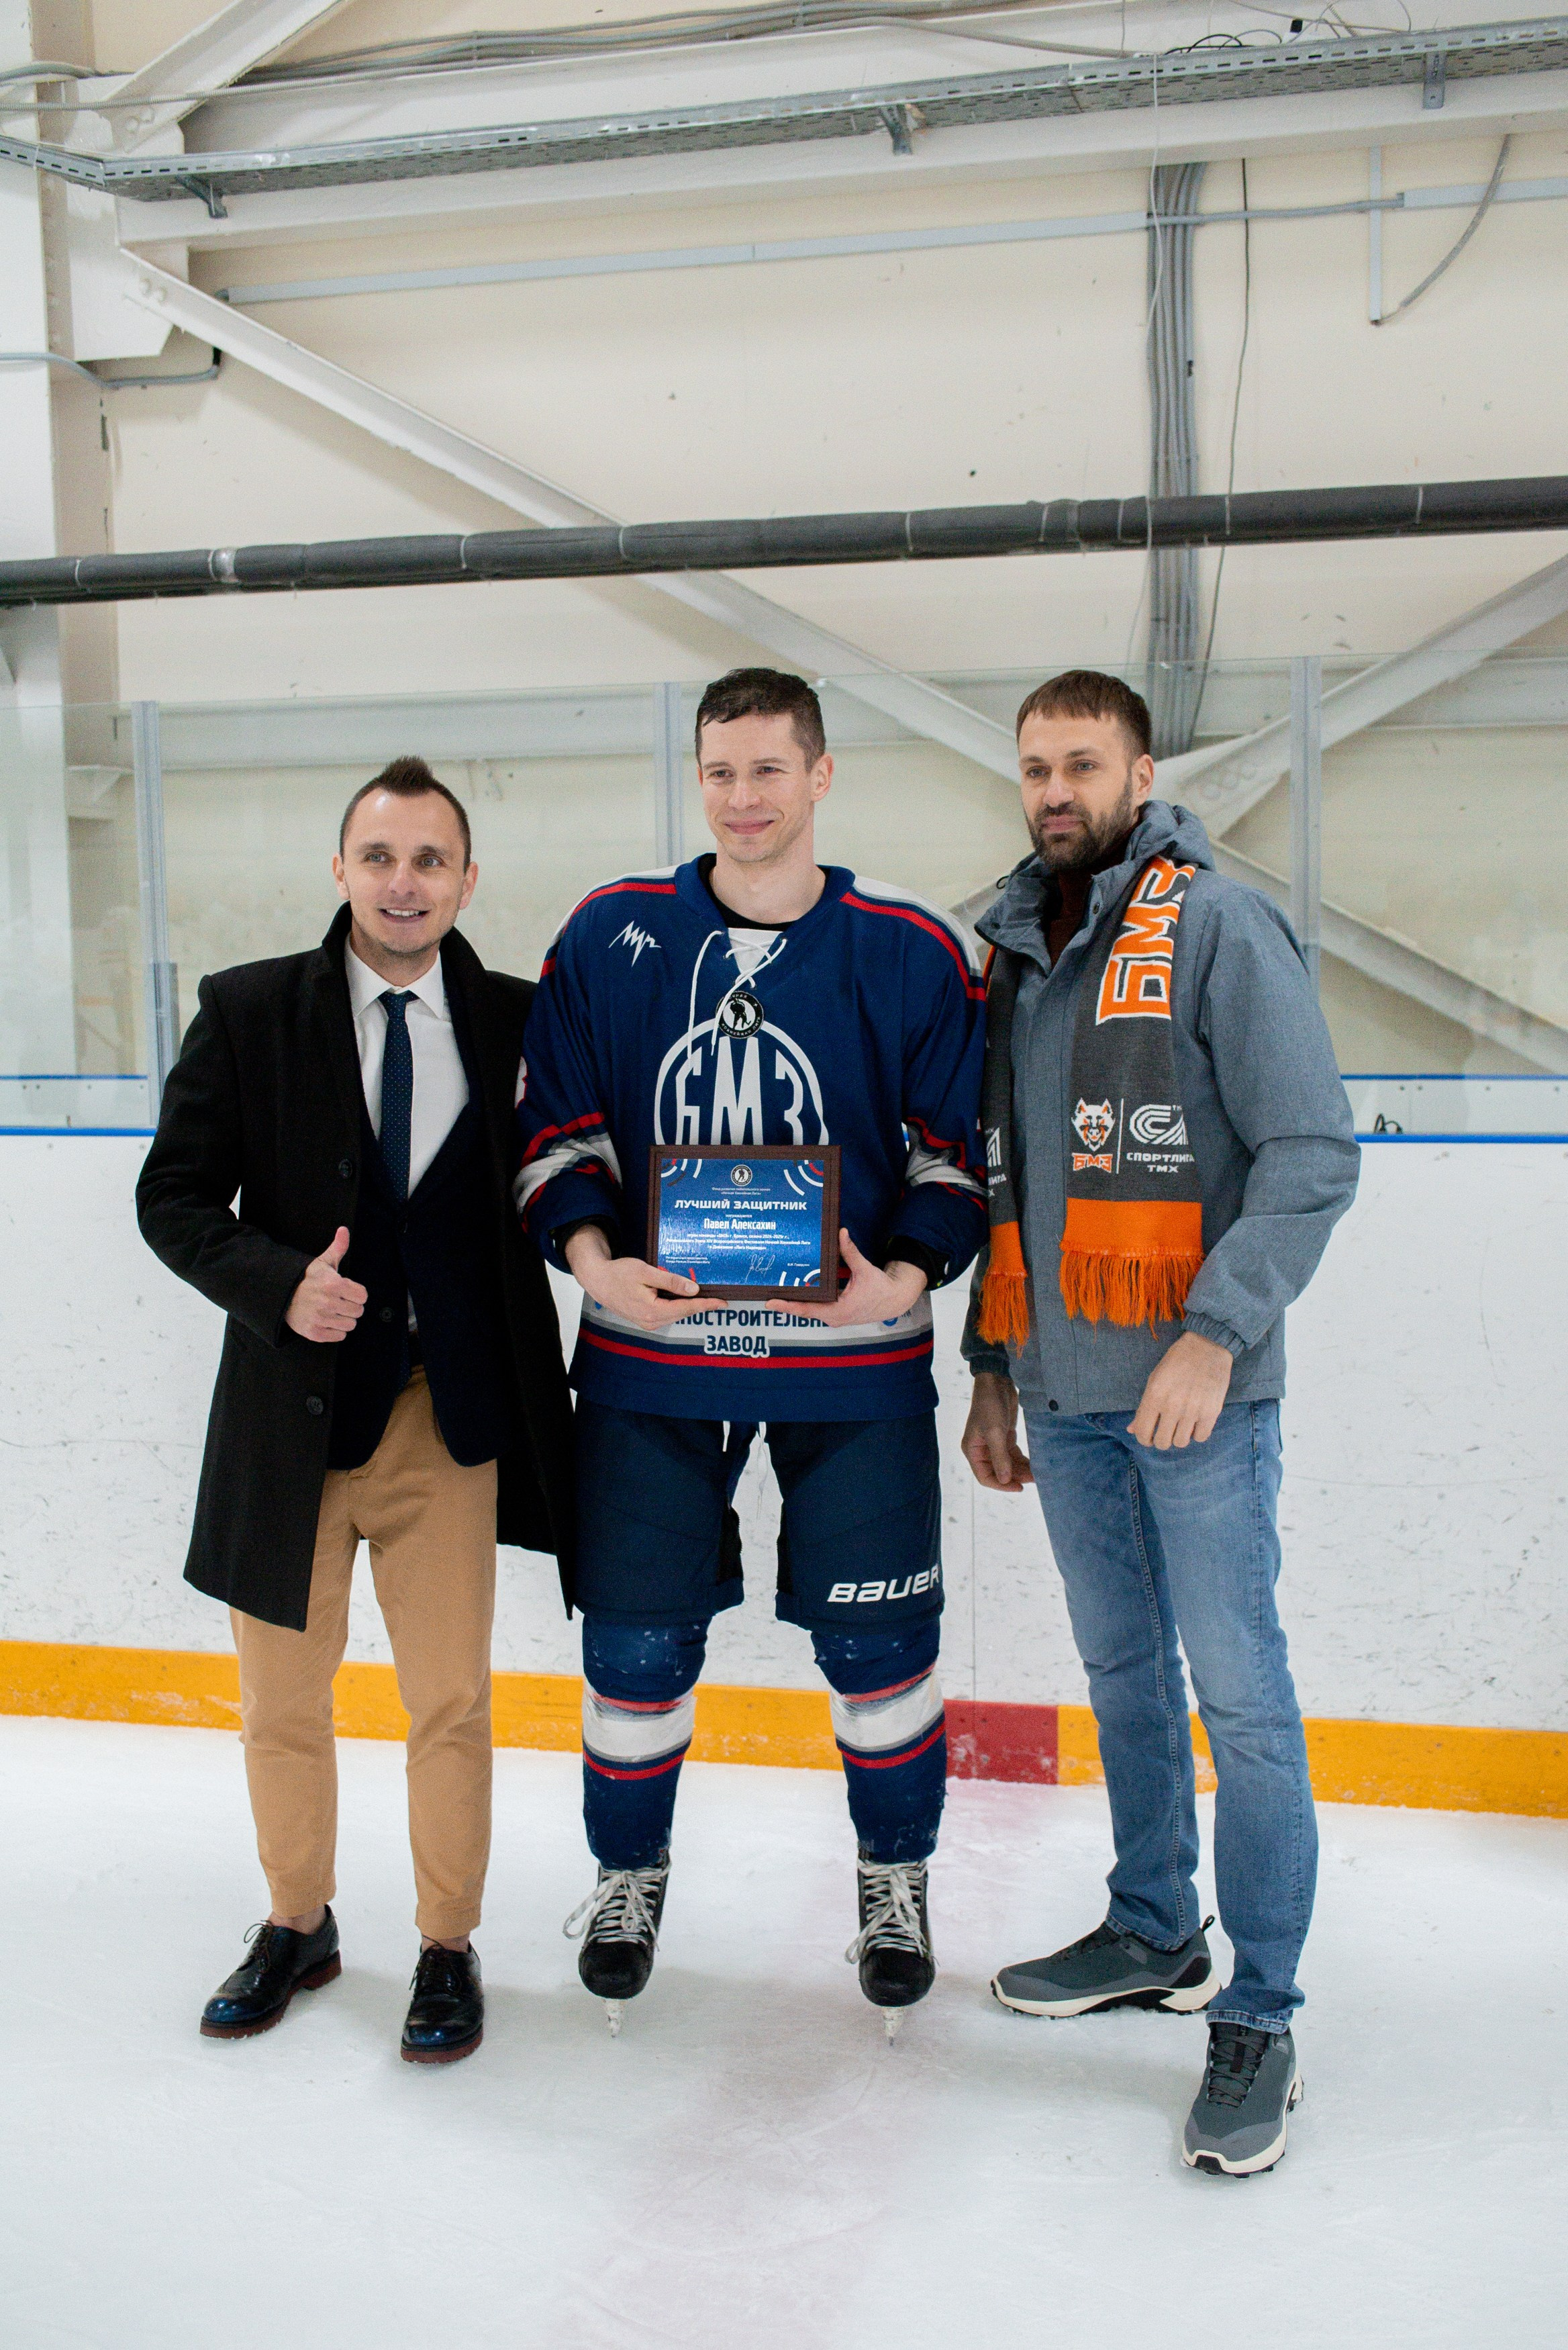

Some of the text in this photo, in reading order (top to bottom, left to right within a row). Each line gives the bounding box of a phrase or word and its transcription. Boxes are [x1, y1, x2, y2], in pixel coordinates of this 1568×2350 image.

[1071, 1152, 1113, 1174] БМЗ
[1126, 1152, 1195, 1163] СПОРТЛИГА
[1147, 1164, 1179, 1173] ТМХ
[675, 1198, 807, 1211] ЛУЧШИЙ ЗАЩИТНИК
[704, 1218, 776, 1230] Павел Алексахин
[707, 1335, 767, 1355] ЗАВОД
